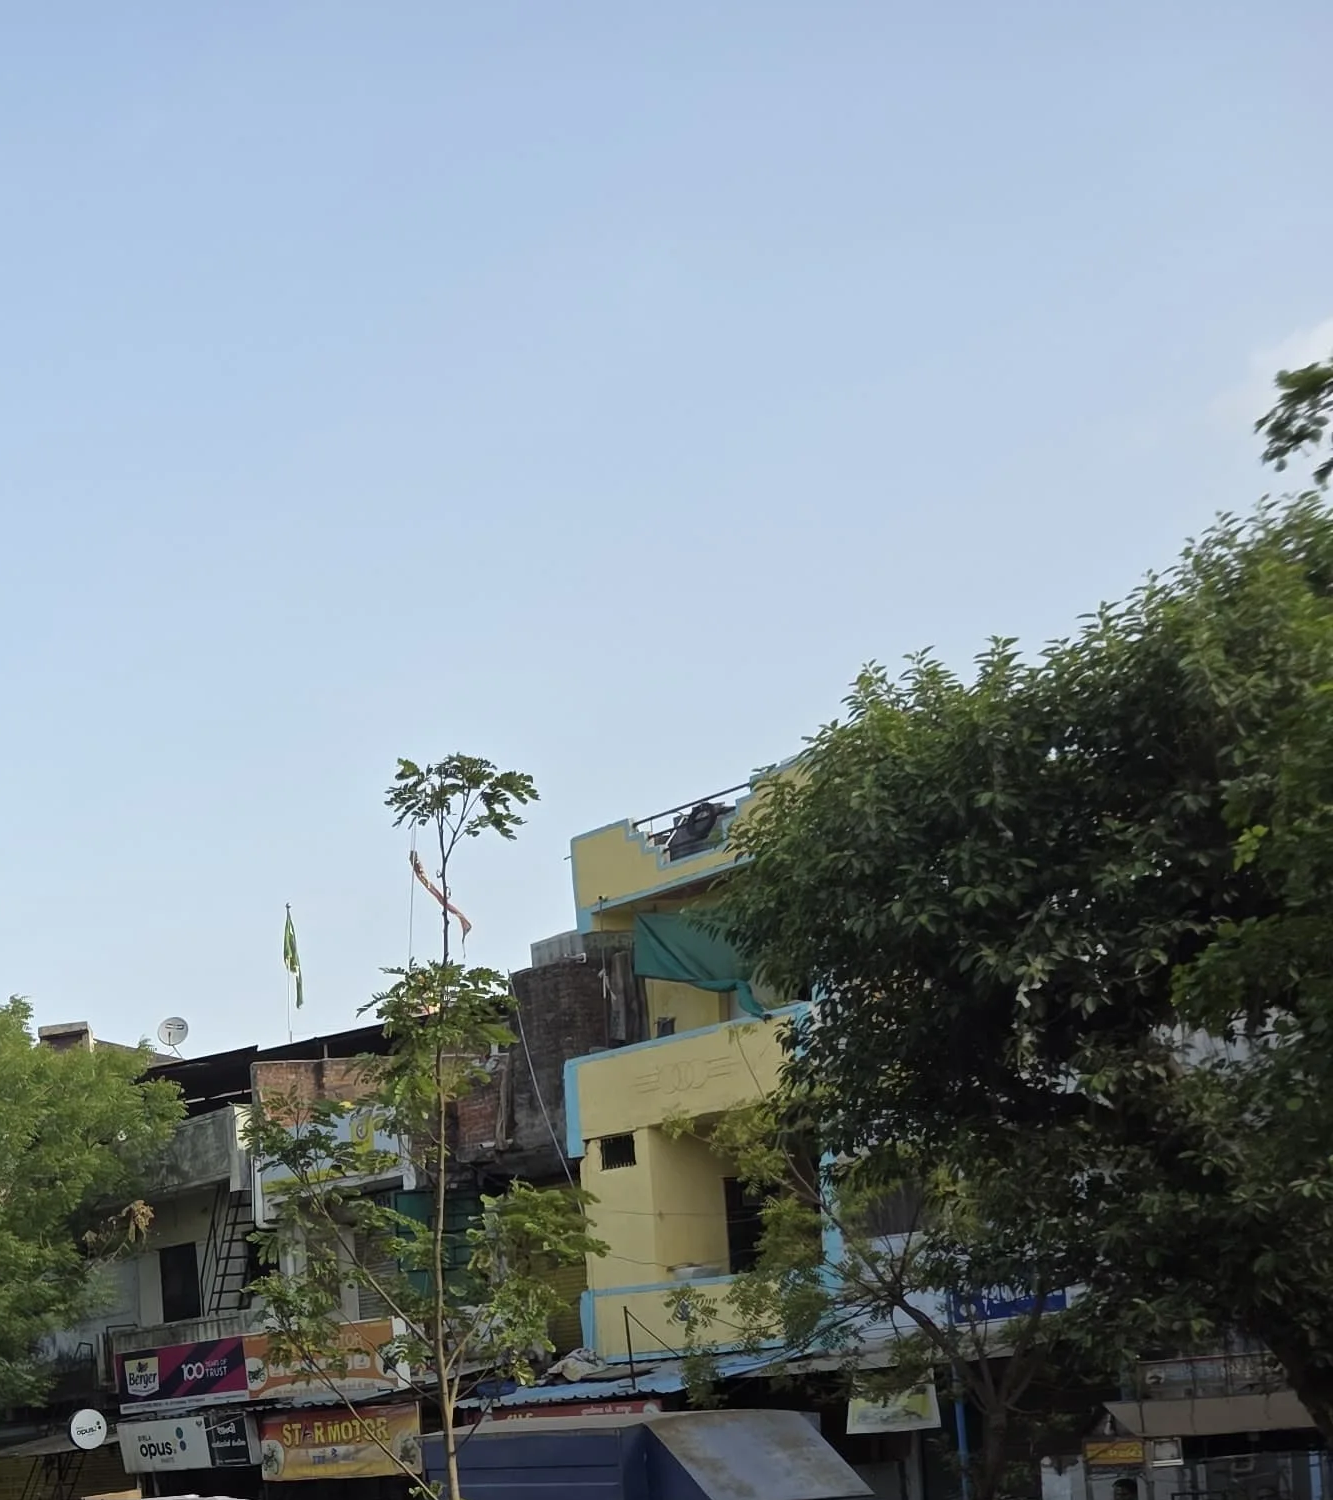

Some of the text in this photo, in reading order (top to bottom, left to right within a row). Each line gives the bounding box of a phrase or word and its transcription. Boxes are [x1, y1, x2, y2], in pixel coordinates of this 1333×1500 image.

[181, 1361, 204, 1381] 100
[205, 1366, 228, 1379] TRUST
[129, 1371, 159, 1392] Berger
[139, 1441, 174, 1459] opus
